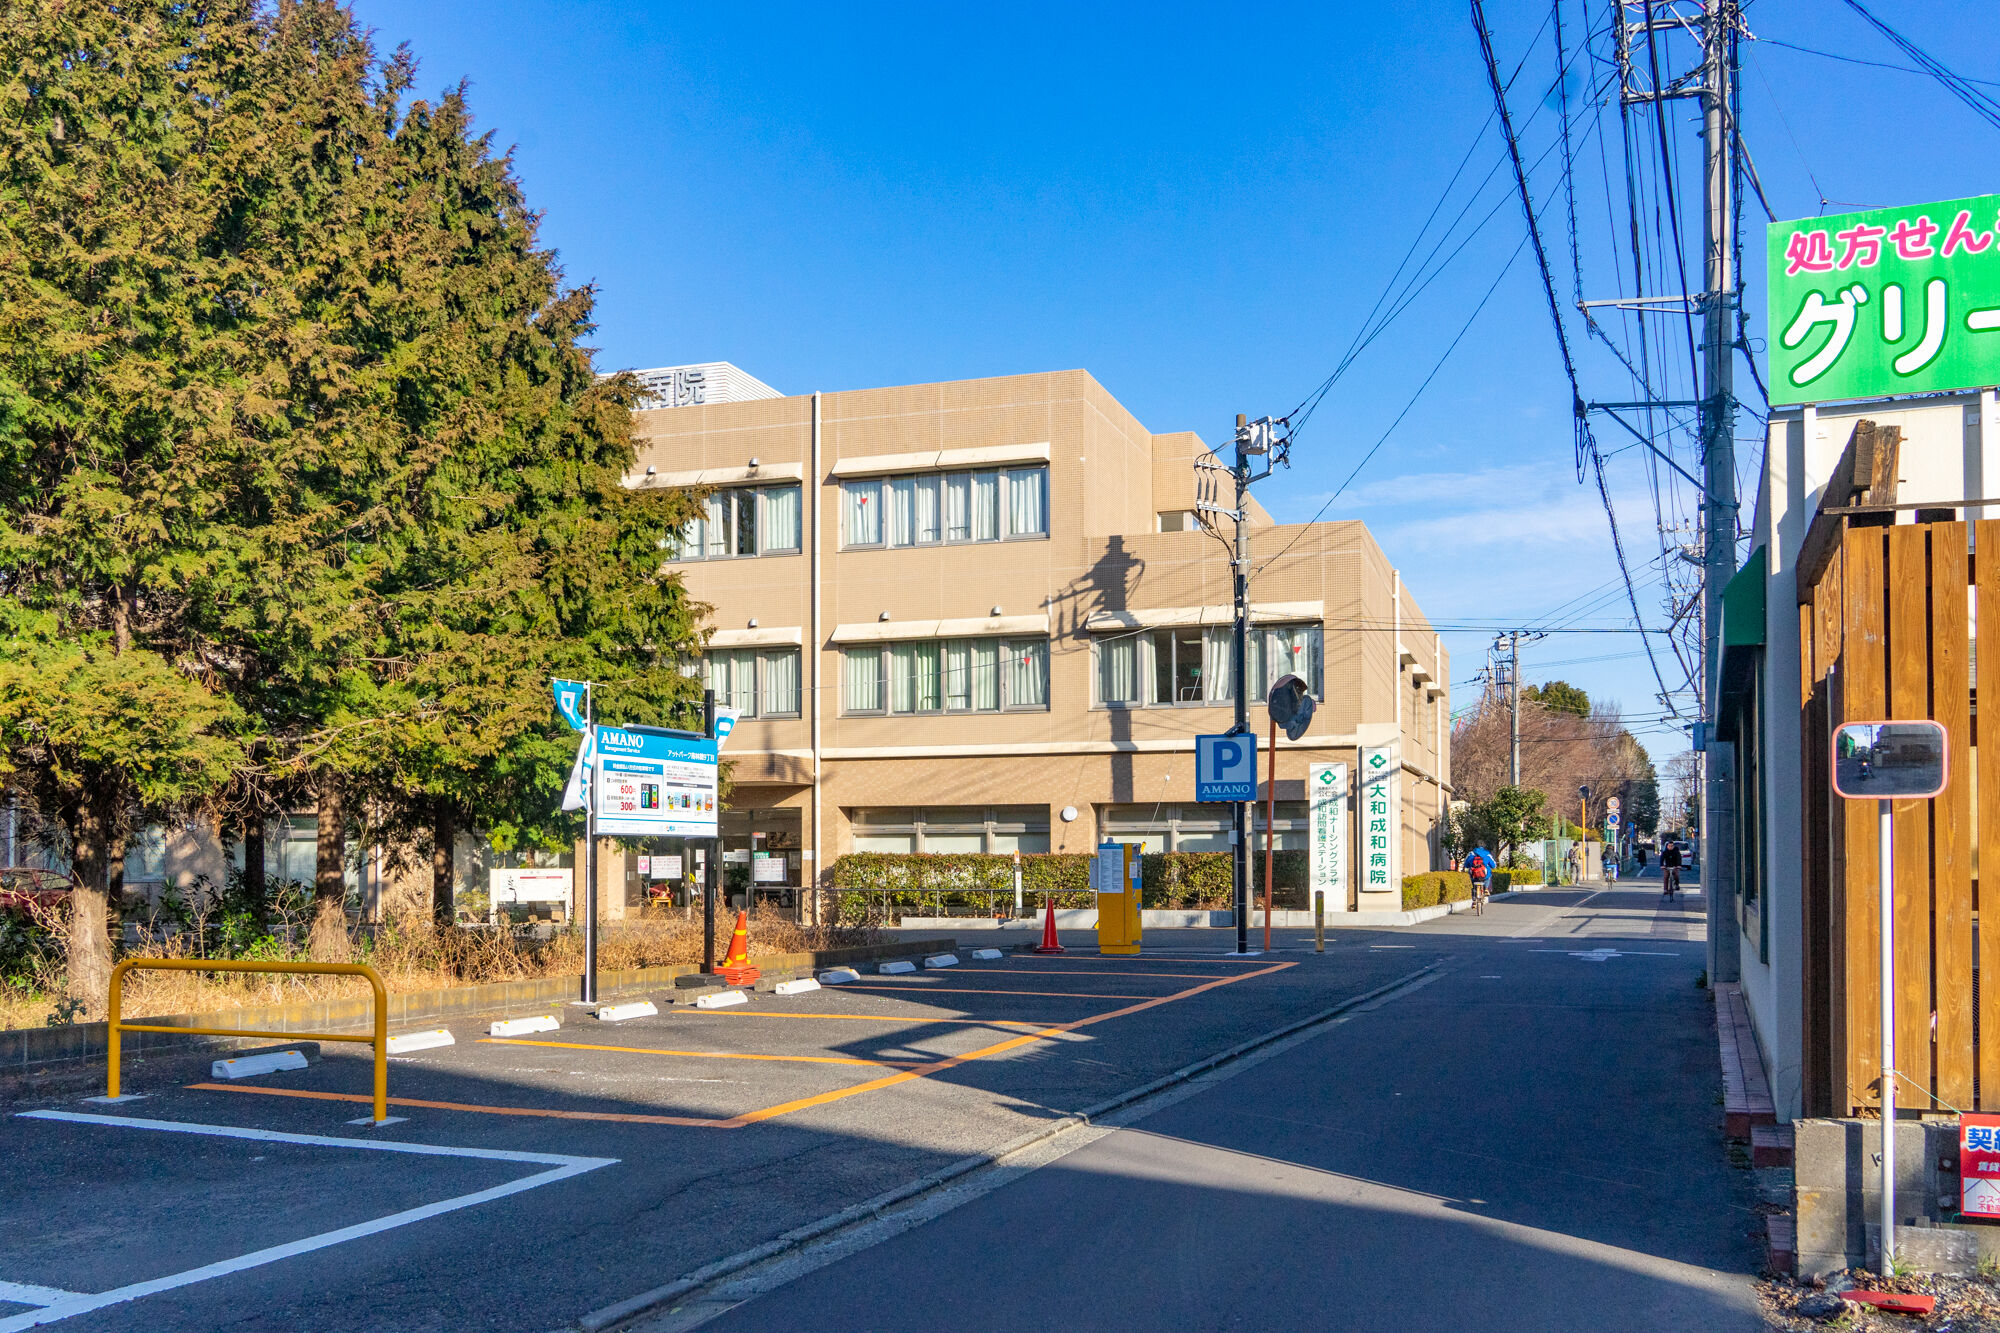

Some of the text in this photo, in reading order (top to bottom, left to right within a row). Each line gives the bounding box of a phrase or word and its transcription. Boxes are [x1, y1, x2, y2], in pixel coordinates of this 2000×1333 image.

[1786, 211, 2000, 276] 処方せん
[601, 731, 644, 748] AMANO
[1213, 741, 1242, 780] P
[1202, 784, 1250, 794] AMANO
[1369, 783, 1387, 885] 大和成和病院
[1967, 1127, 2000, 1152] 契
